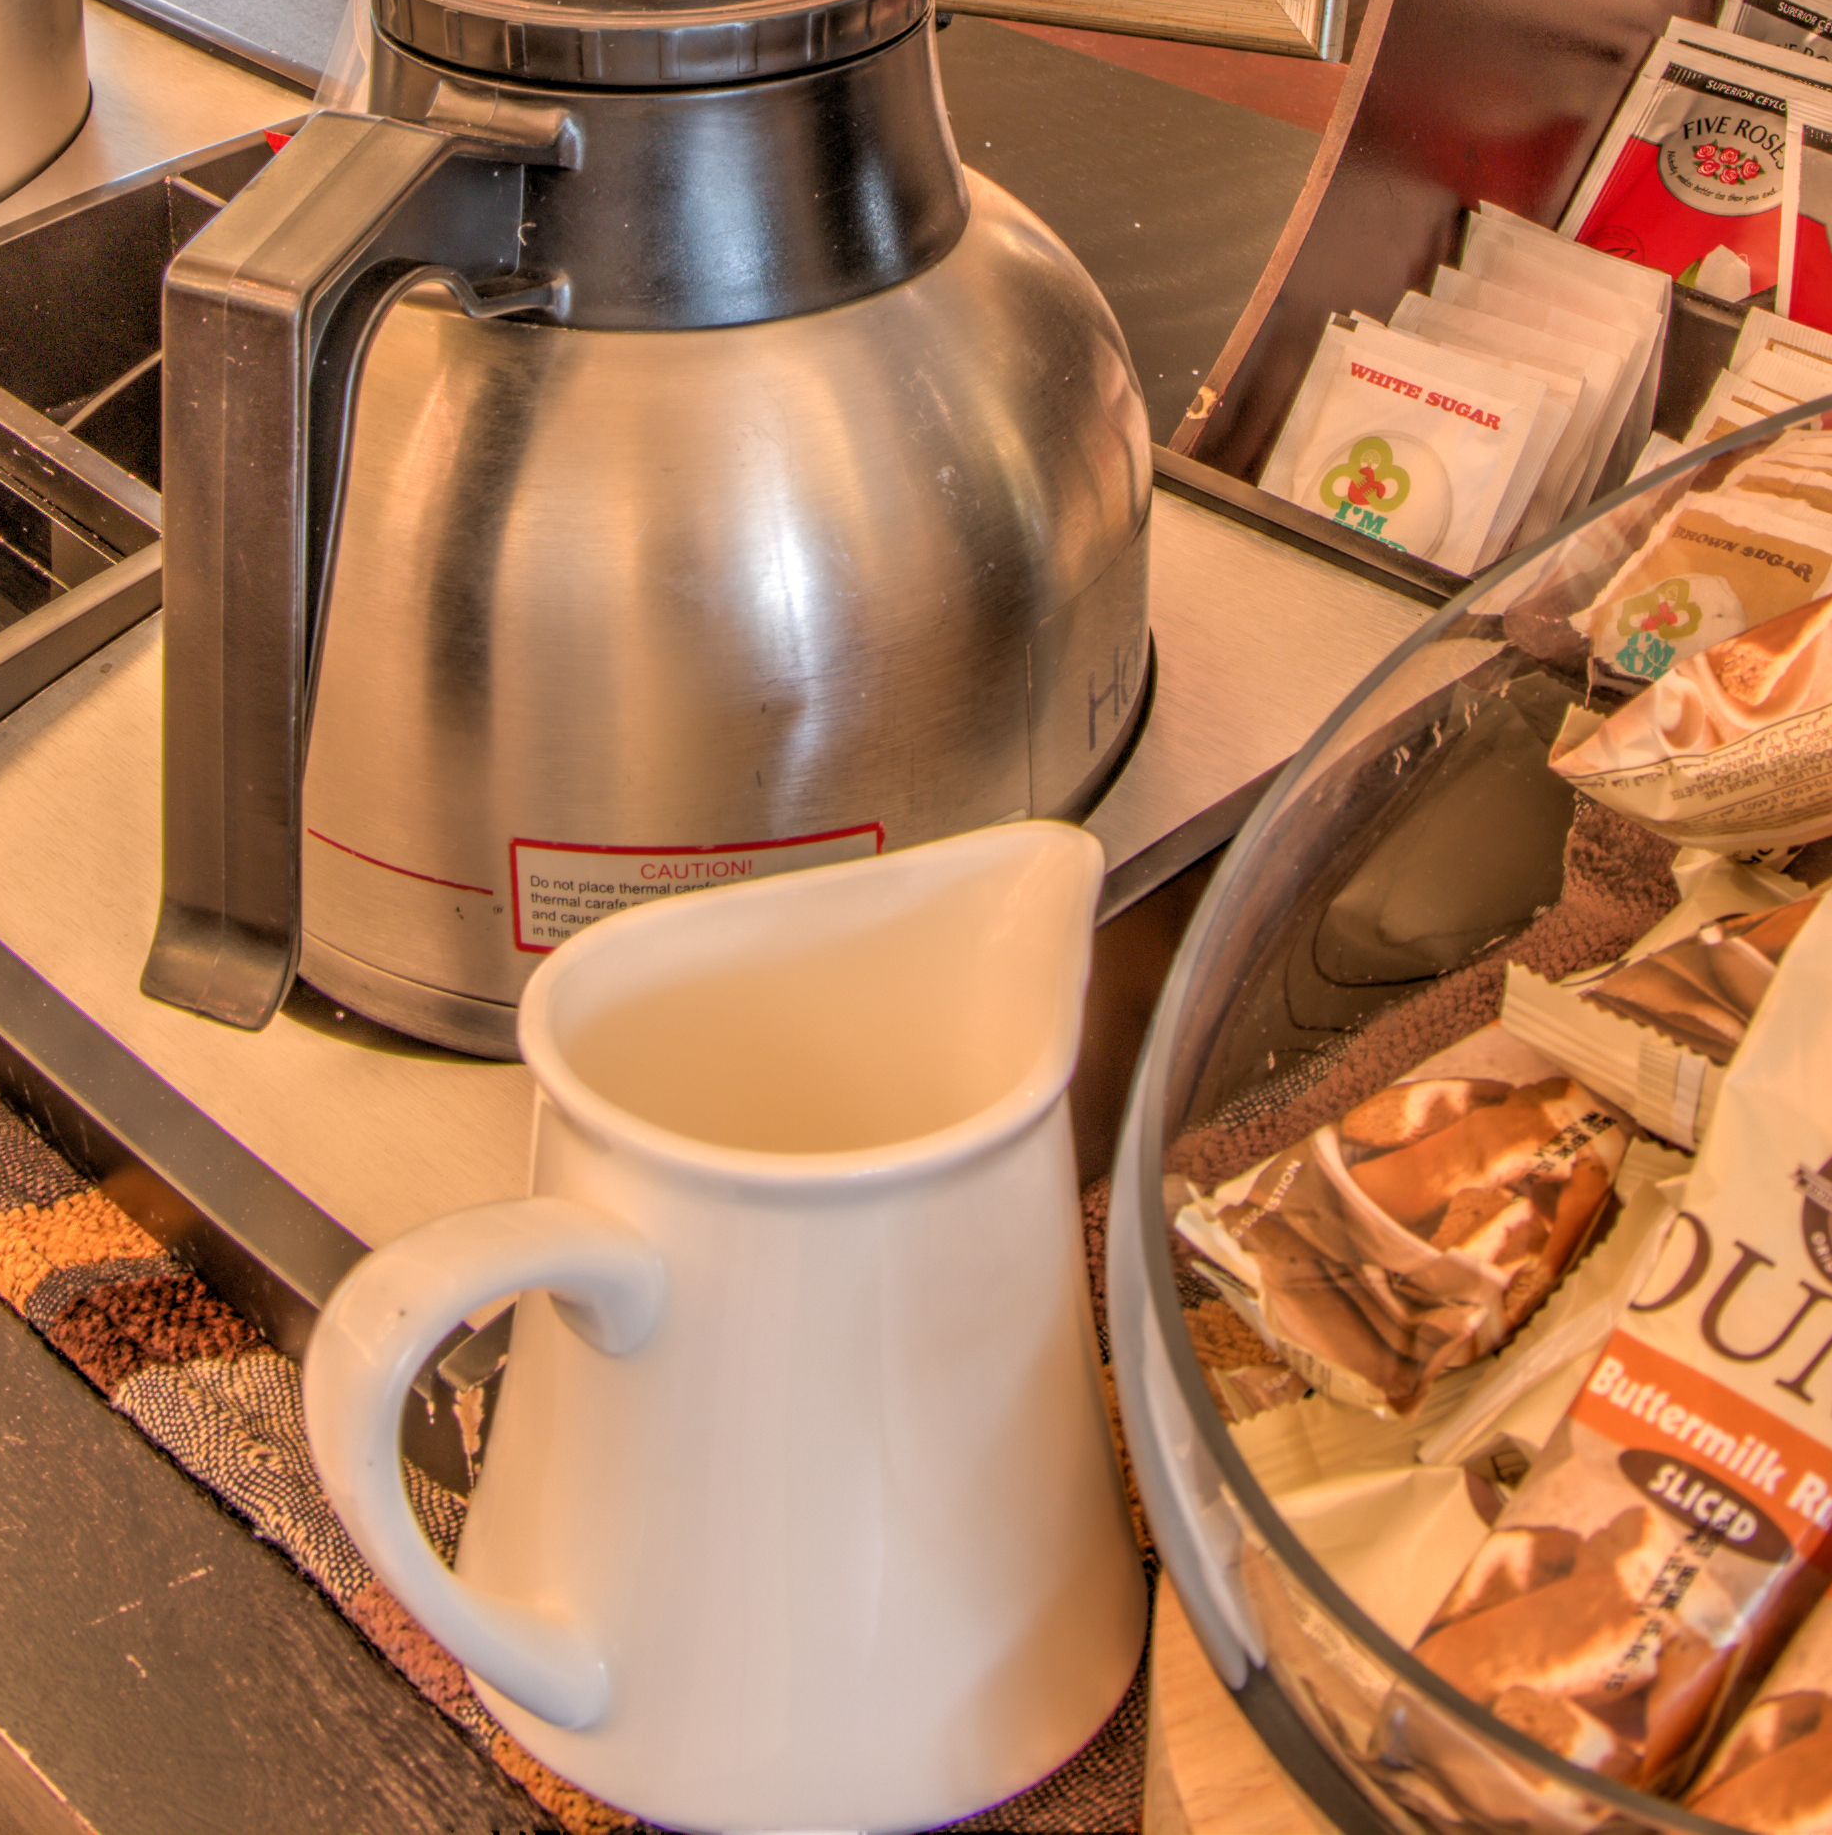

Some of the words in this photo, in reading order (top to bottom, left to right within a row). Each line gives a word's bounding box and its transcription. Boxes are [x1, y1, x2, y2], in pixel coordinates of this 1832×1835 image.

[1778, 2, 1817, 25] SUPERIOR
[1705, 80, 1755, 101] SUPERIOR
[1756, 95, 1787, 111] CEYLO
[1683, 116, 1731, 140] FIVE
[1351, 362, 1423, 399] WHITE
[1425, 392, 1501, 430] SUGAR
[1672, 526, 1741, 552] BROWN
[1741, 546, 1814, 582] SUGAR
[1763, 742, 1784, 757] AO
[1740, 759, 1766, 776] AUX
[1771, 762, 1824, 789] ALLERGY
[1724, 766, 1778, 793] ALLERGIE
[1702, 786, 1724, 801] NIE
[640, 860, 752, 879] CAUTION!
[530, 876, 549, 888] Do
[554, 878, 574, 891] not
[579, 880, 614, 894] place
[620, 883, 670, 894] thermal
[531, 893, 580, 908] thermal
[586, 899, 627, 910] carafe
[532, 909, 556, 922] and
[533, 925, 543, 936] in
[549, 926, 571, 938] this
[1588, 1354, 1787, 1496] Buttermilk
[1647, 1464, 1758, 1543] SLICED
